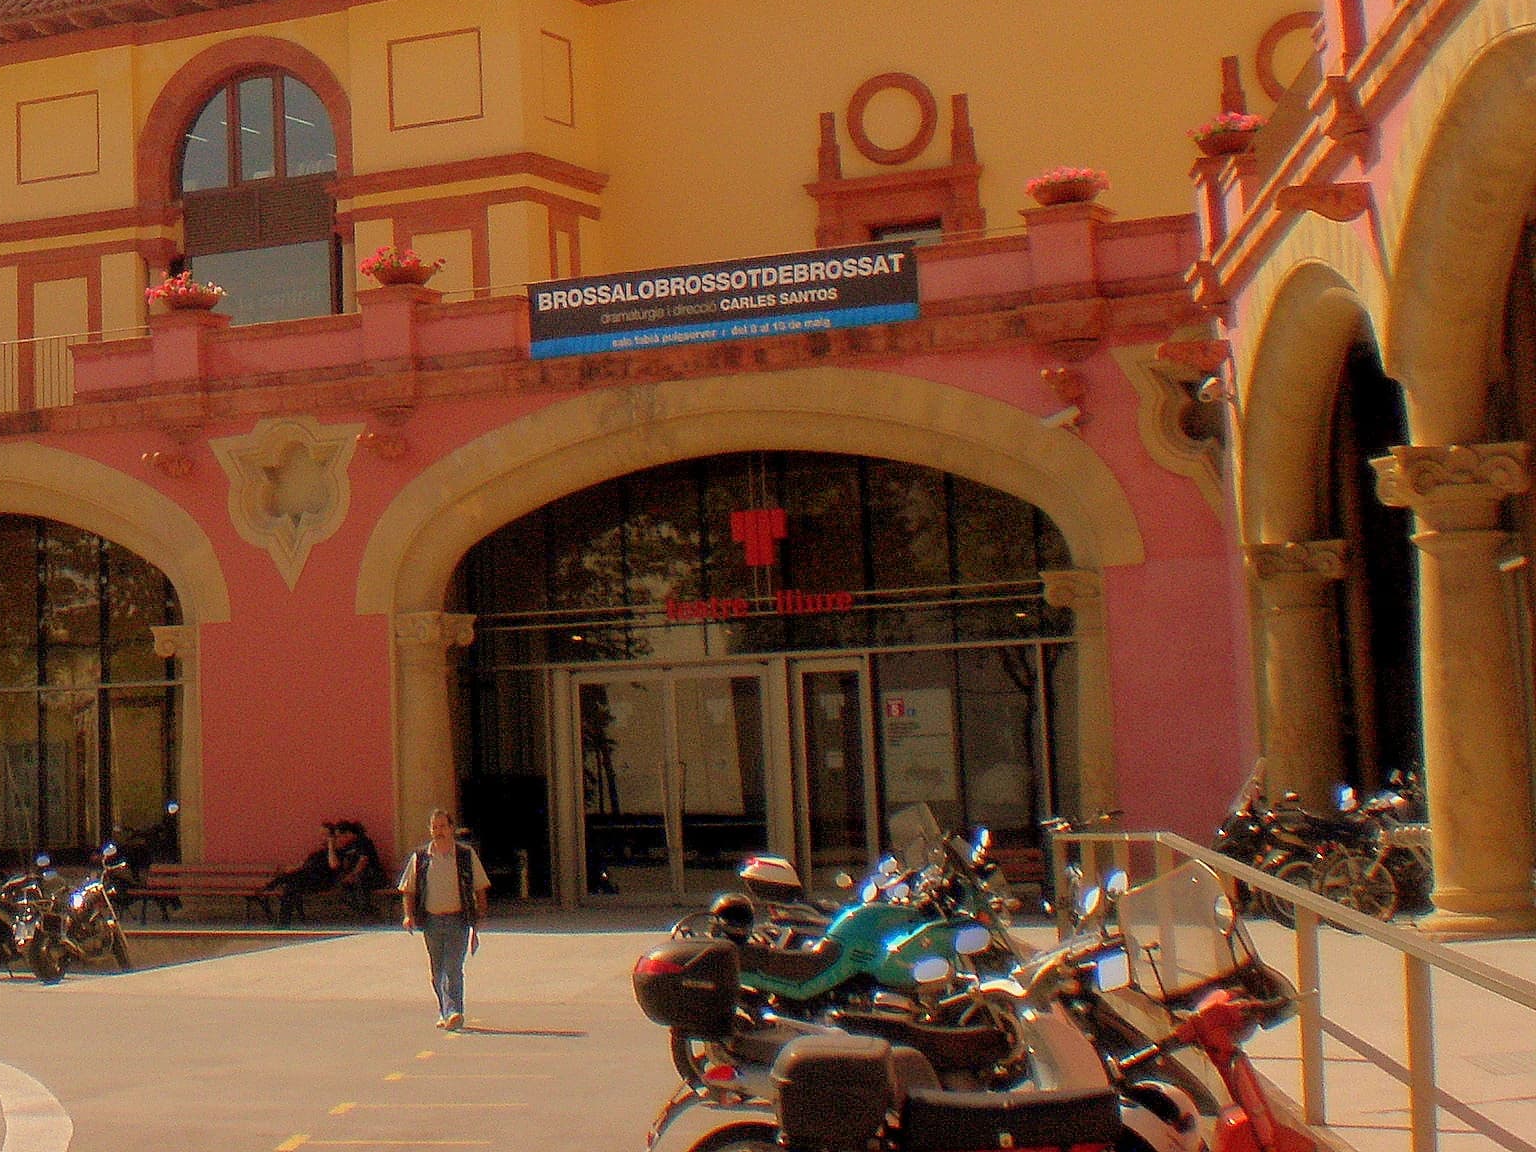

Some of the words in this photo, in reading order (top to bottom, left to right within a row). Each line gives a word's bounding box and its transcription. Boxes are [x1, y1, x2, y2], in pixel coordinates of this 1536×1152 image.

[537, 253, 905, 312] BROSSALOBROSSOTDEBROSSAT
[720, 294, 776, 311] CARLES
[779, 287, 839, 305] SANTOS
[666, 597, 749, 621] teatre
